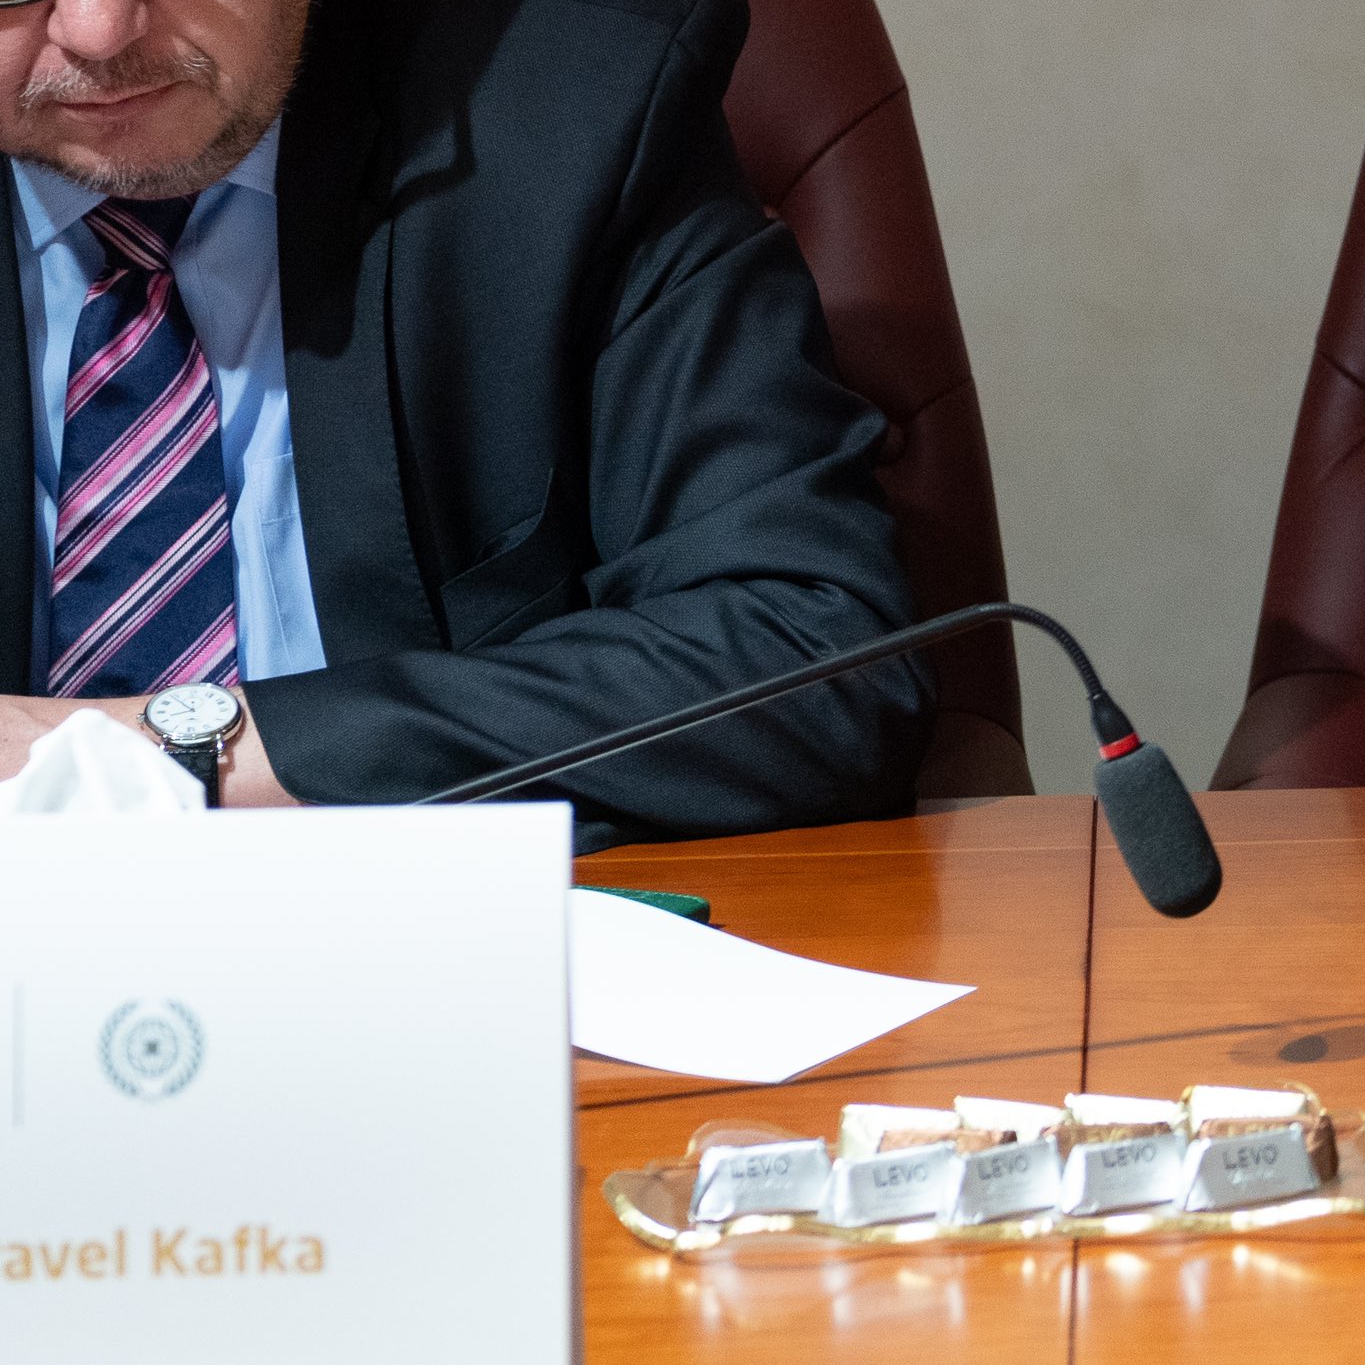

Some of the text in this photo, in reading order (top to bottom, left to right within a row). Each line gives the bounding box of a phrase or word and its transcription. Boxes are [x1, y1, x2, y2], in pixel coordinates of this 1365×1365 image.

[730, 1153, 792, 1179] LEVO
[976, 1153, 1029, 1180] LEVO
[1101, 1142, 1156, 1168] LEVO
[1222, 1142, 1279, 1171] LEVO
[872, 1162, 929, 1188] LEVO
[0, 1223, 326, 1281] avel Kafka
